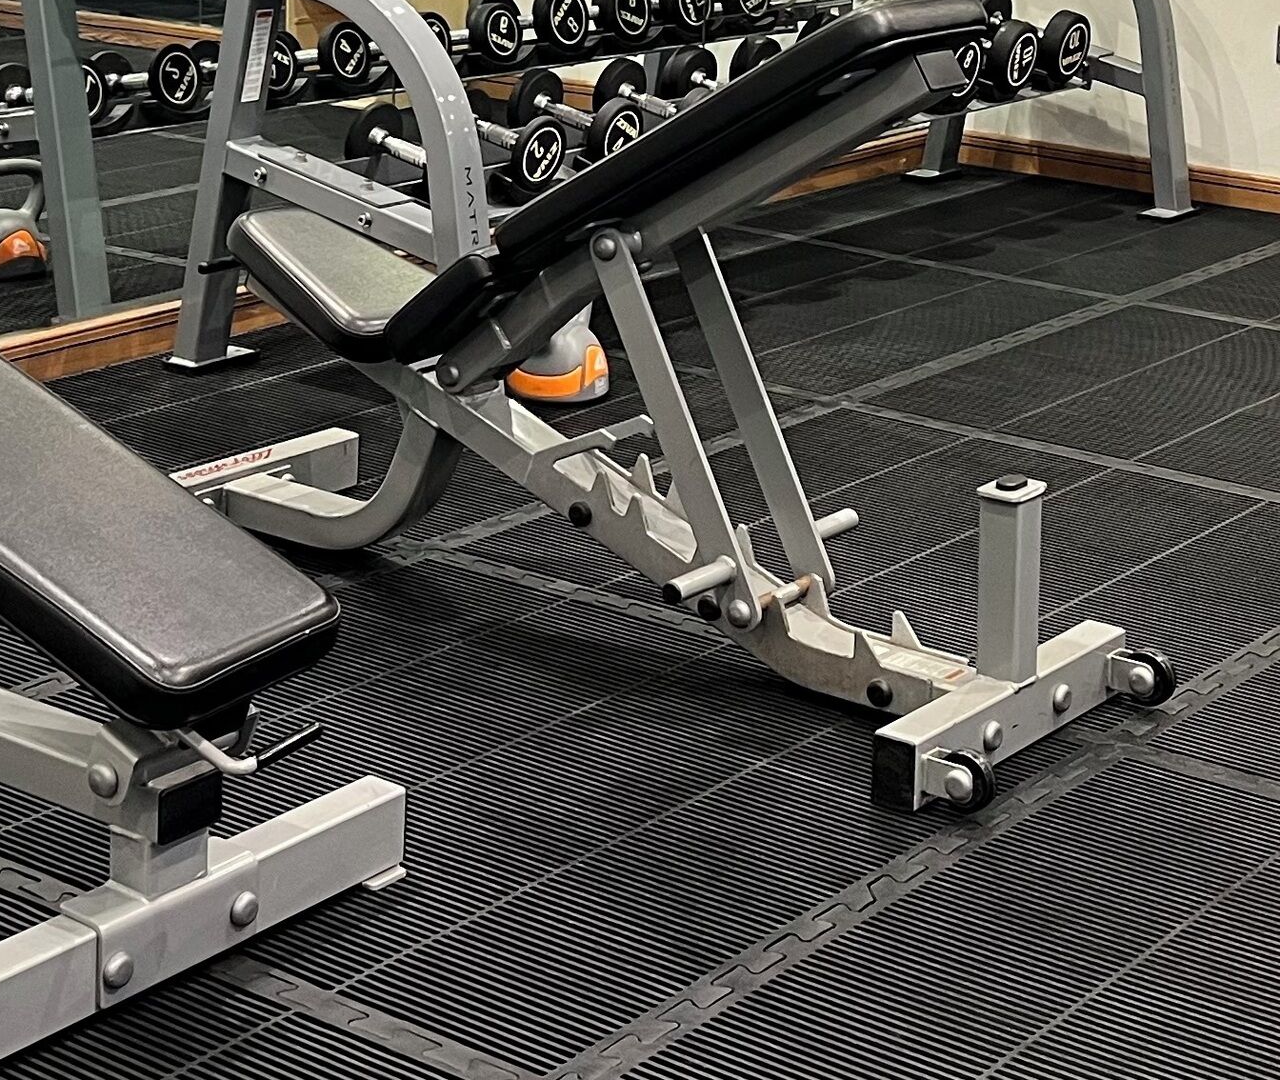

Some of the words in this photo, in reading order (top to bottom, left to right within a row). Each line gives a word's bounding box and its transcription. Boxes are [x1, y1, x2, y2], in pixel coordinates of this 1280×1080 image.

[963, 49, 974, 69] 8
[529, 139, 545, 159] 2
[465, 167, 480, 246] MATR
